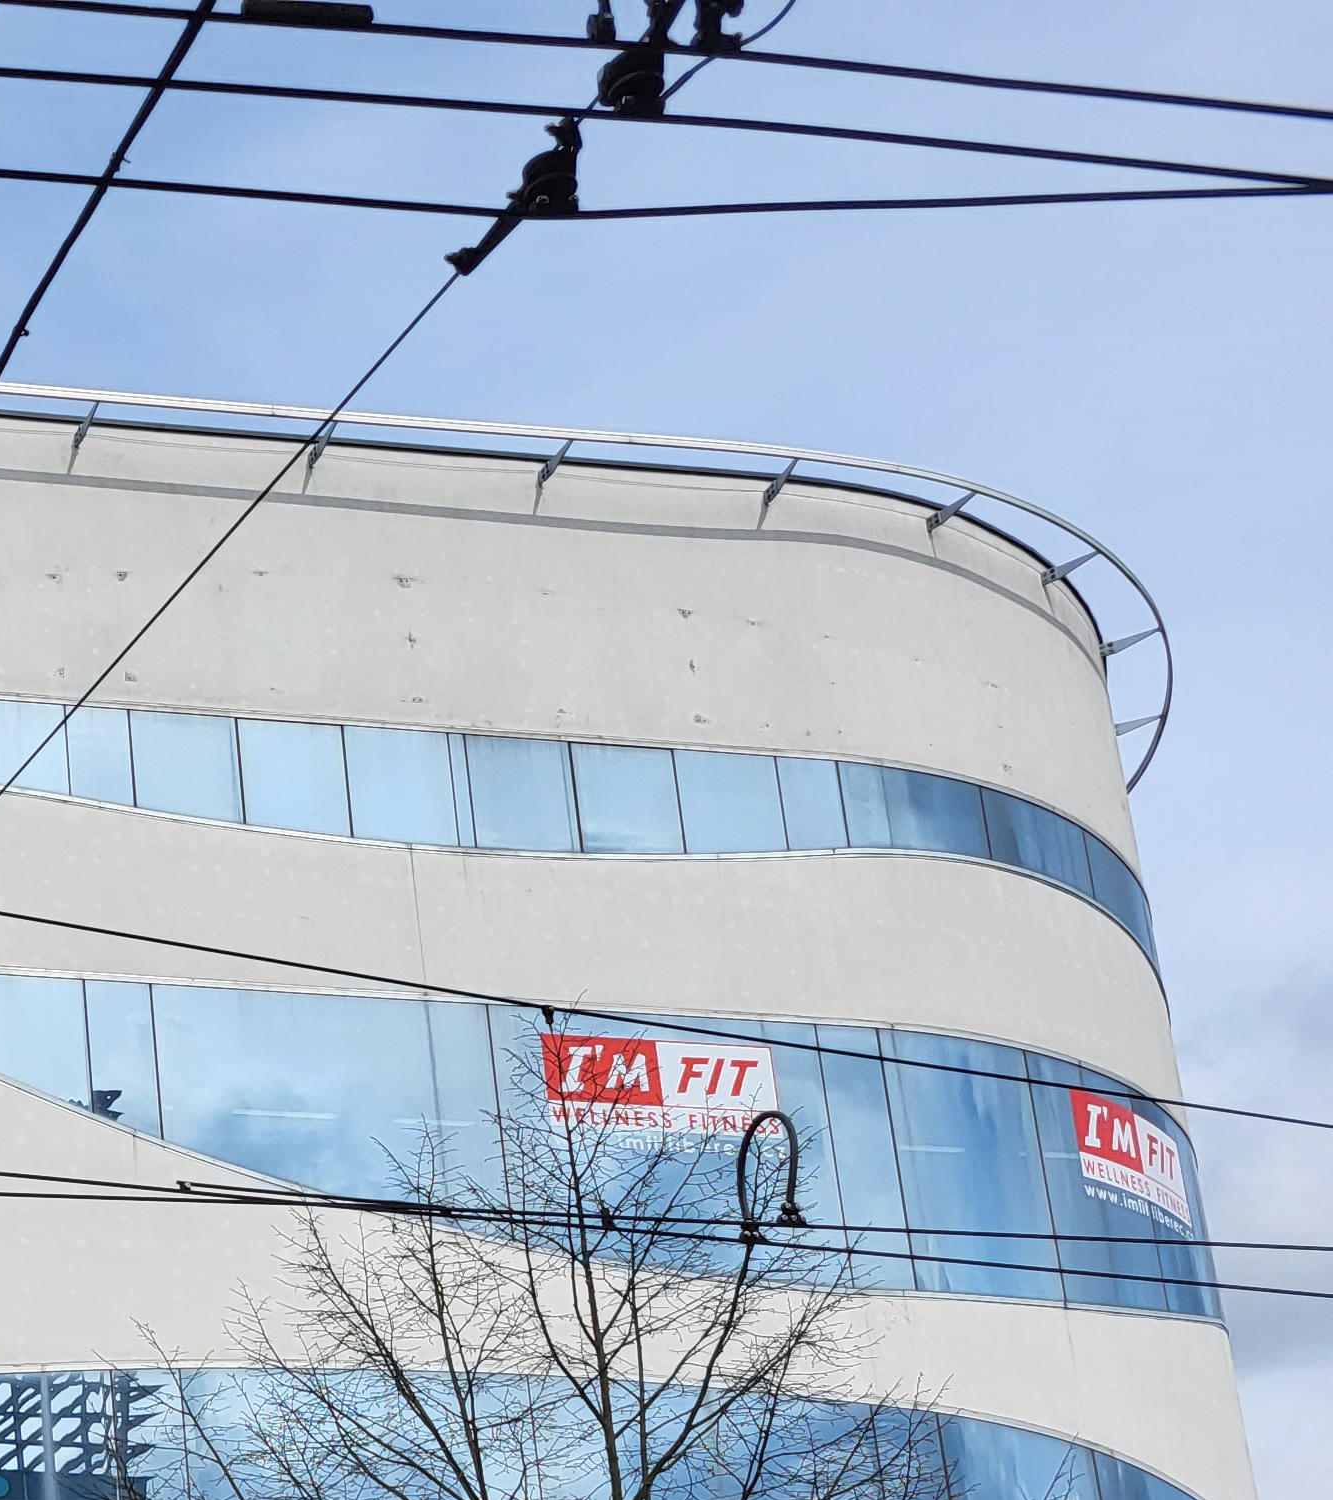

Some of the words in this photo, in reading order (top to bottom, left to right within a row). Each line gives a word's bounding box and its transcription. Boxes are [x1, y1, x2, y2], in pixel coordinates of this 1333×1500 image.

[559, 1044, 650, 1093] I'M
[677, 1057, 760, 1097] FIT
[551, 1106, 673, 1129] WELLNESS
[688, 1113, 780, 1135] FITNESS
[1085, 1103, 1137, 1159] I'M
[1146, 1133, 1176, 1181] FIT
[1083, 1158, 1151, 1197] WELLNESS
